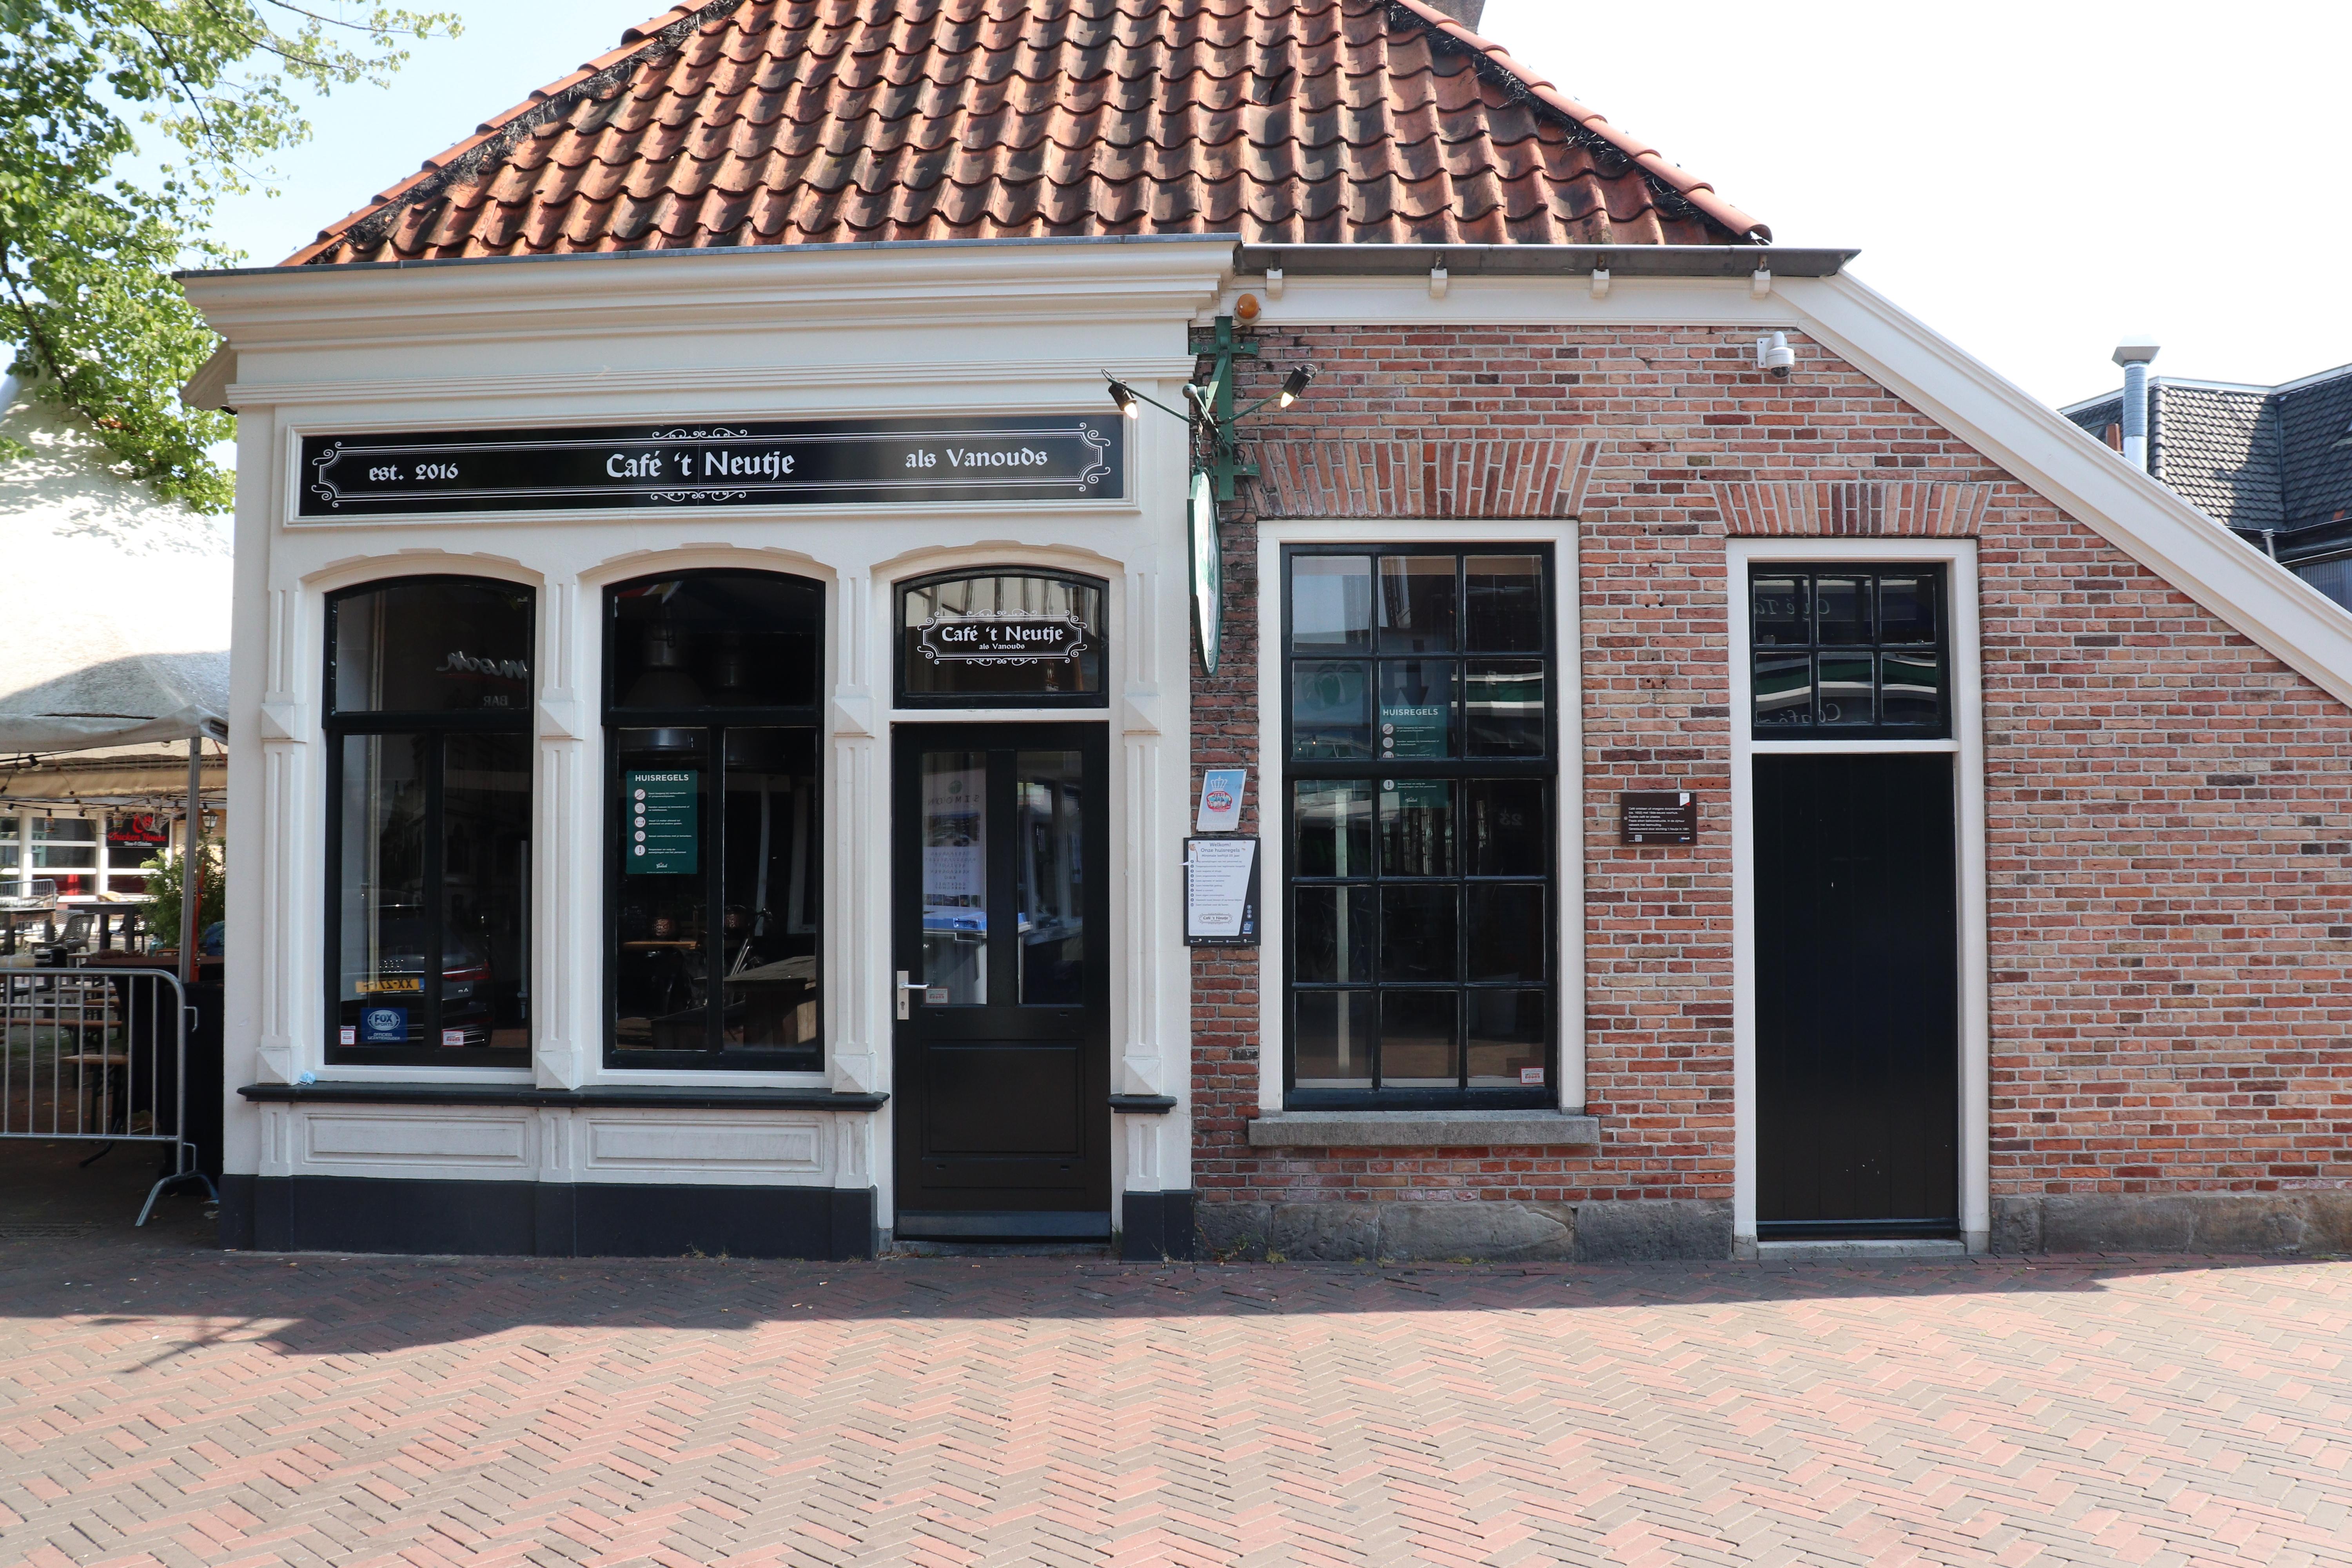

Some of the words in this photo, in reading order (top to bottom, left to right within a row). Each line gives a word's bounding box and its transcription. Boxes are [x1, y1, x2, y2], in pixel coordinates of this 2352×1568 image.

[606, 451, 662, 478] Café
[704, 450, 795, 481] Neutje
[906, 450, 936, 468] als
[946, 447, 1048, 467] Vanouds
[369, 464, 404, 481] est.
[416, 463, 458, 480] 2016
[942, 625, 978, 642] Café
[1006, 625, 1063, 644] Neutje
[108, 831, 140, 841] Chicken
[142, 833, 166, 841] House
[374, 1014, 393, 1022] FOX
